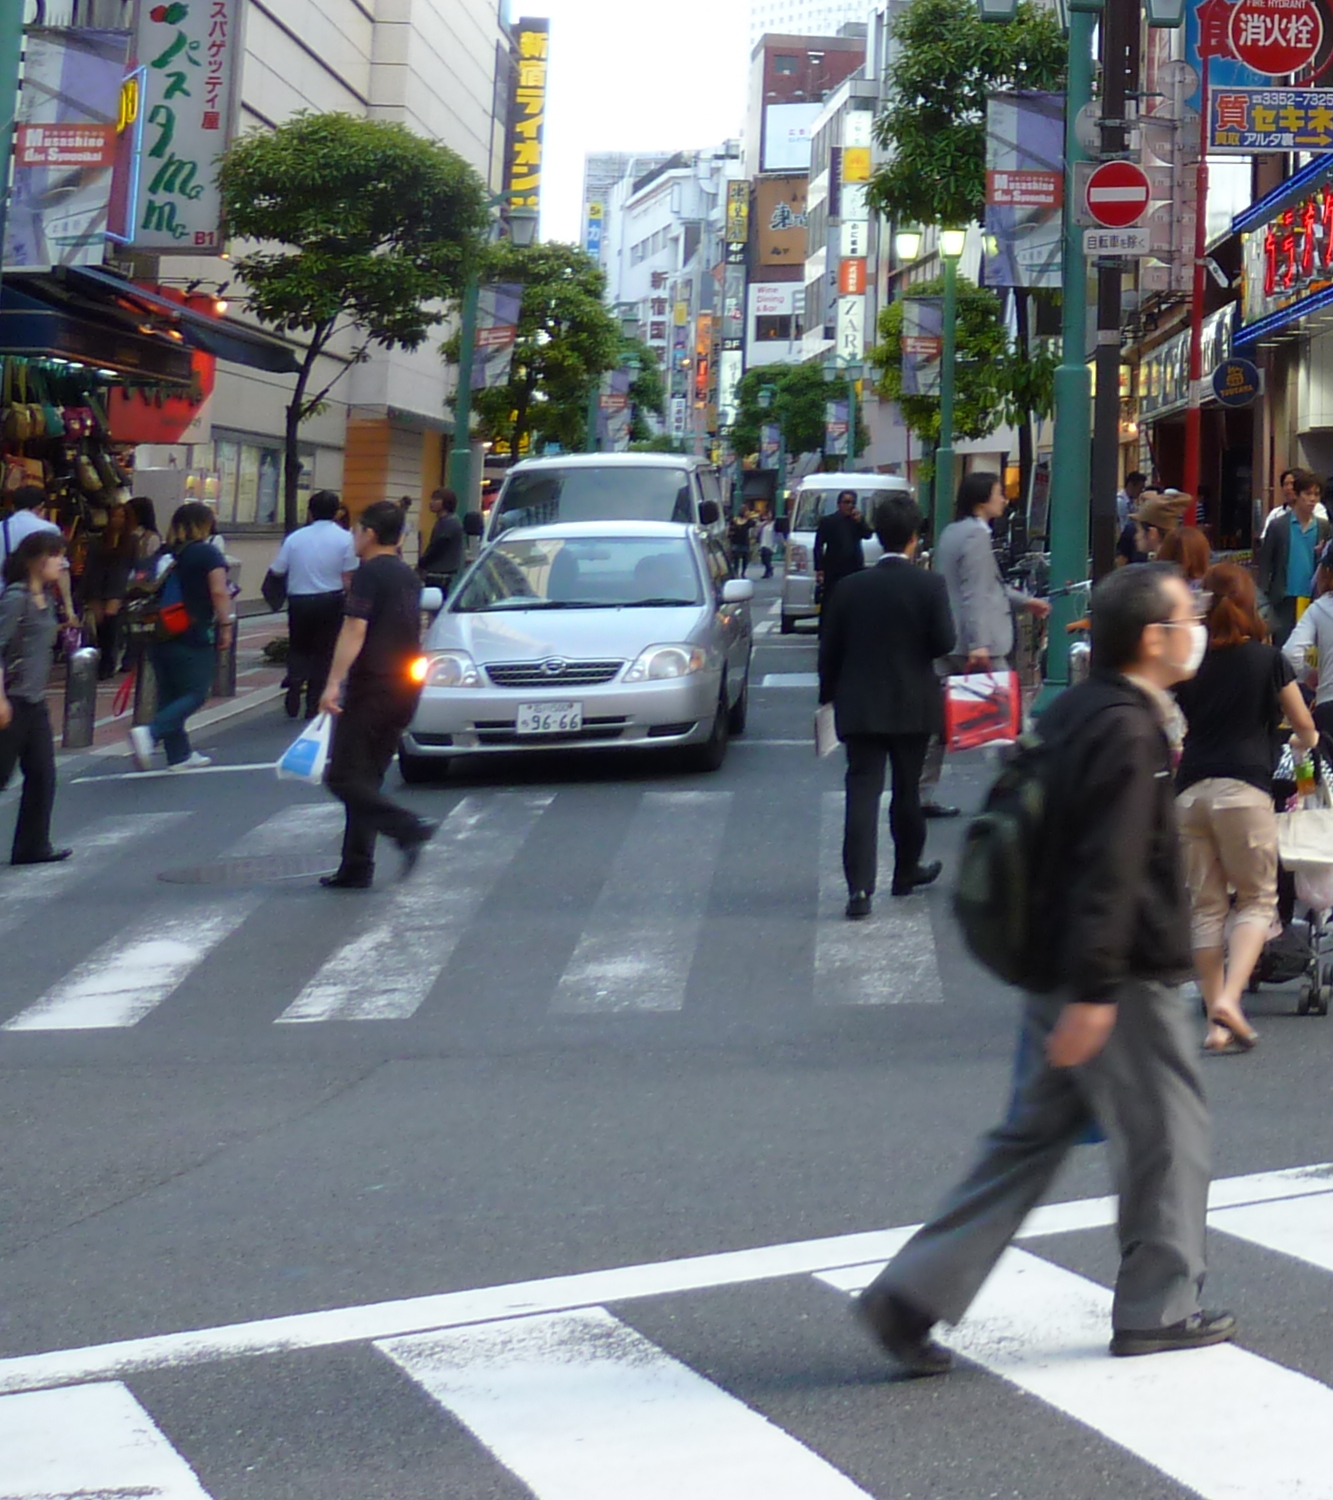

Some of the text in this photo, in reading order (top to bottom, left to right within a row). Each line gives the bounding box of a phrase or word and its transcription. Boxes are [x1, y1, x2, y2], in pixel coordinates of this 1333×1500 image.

[1238, 14, 1314, 49] 消火栓
[1215, 93, 1250, 132] 質
[25, 128, 105, 148] Musashino
[1244, 132, 1295, 147] アルタ裏
[193, 231, 214, 246] B1
[1086, 234, 1146, 250] 自転車を除く
[728, 254, 744, 263] 4F
[756, 296, 785, 304] Dining
[531, 713, 579, 731] 96-66
